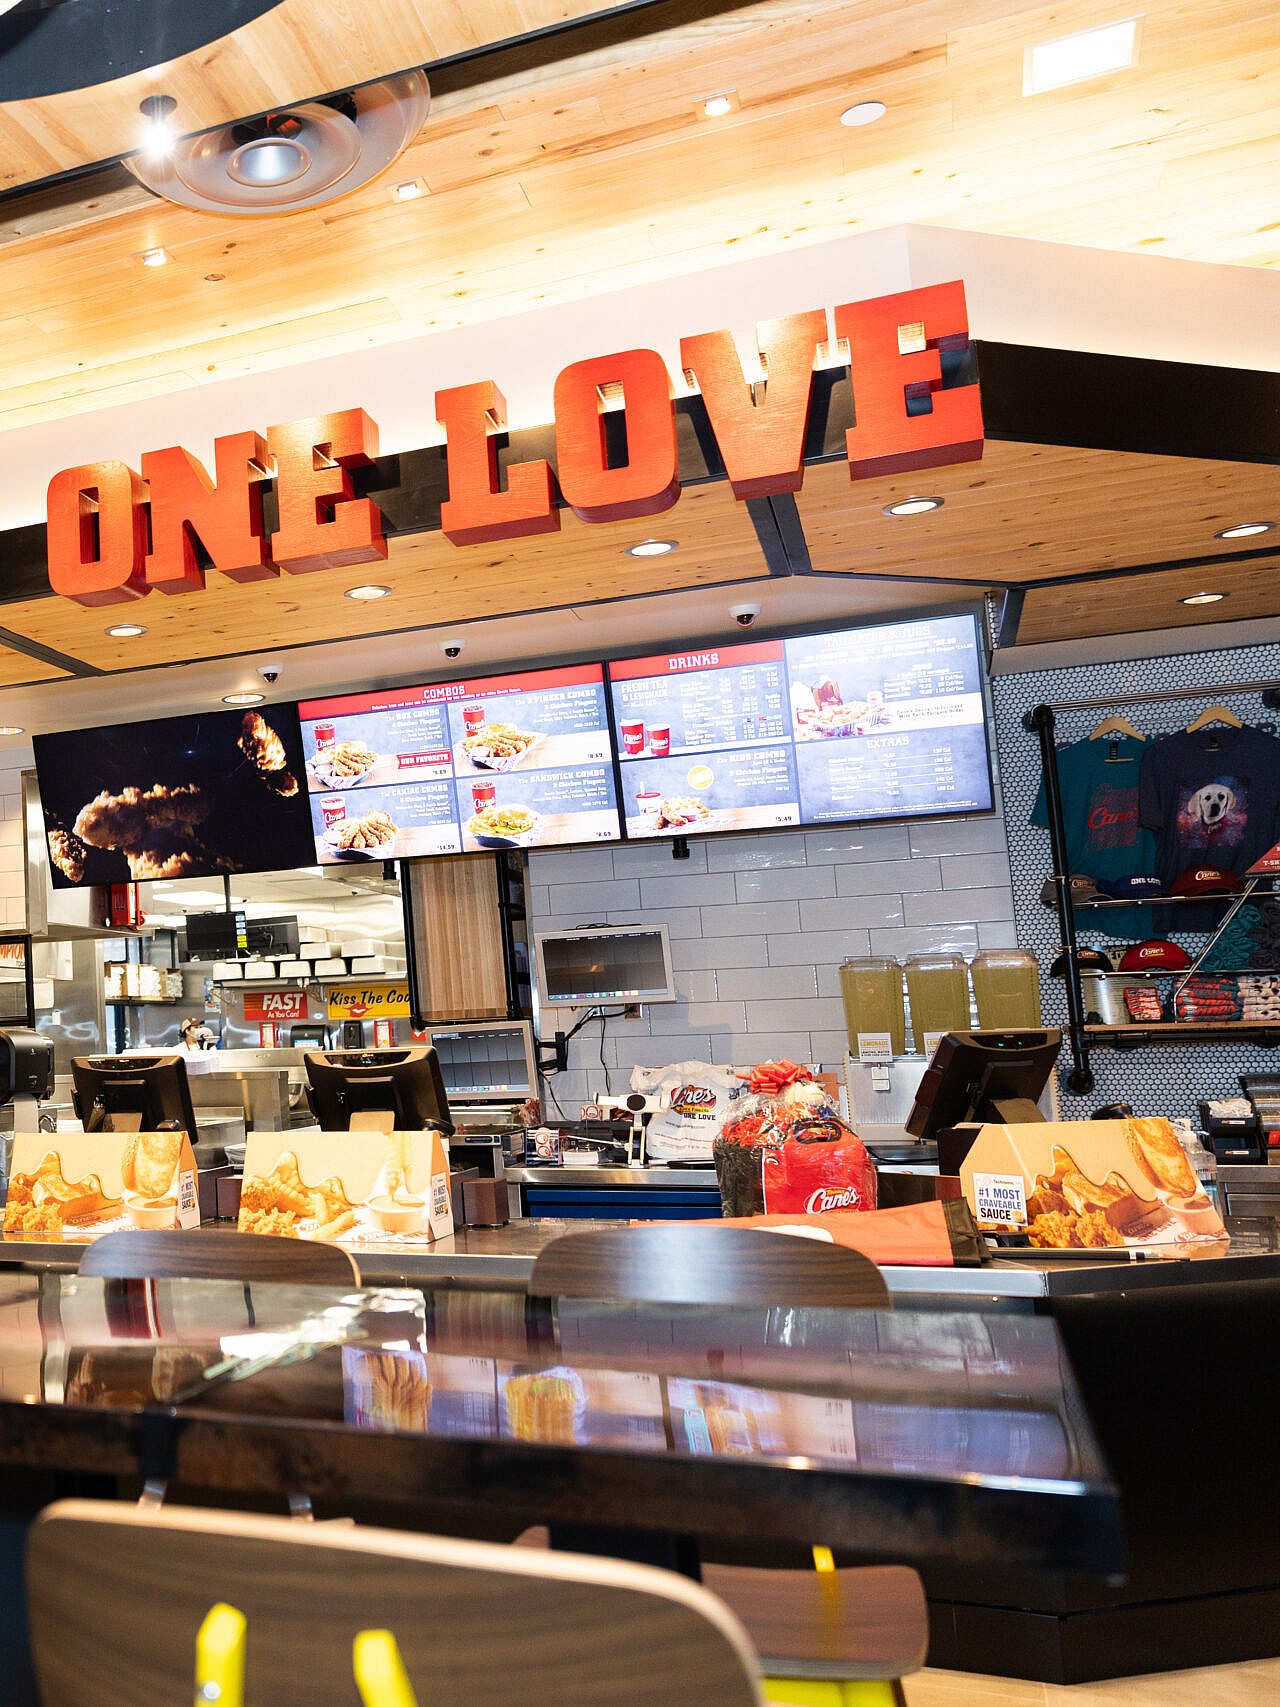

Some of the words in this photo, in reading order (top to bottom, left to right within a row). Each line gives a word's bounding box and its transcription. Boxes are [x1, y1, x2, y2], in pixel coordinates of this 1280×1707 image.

[47, 408, 388, 608] ONE
[434, 280, 983, 547] LOVE
[669, 653, 720, 670] DRINKS
[424, 685, 465, 699] COMBOS
[621, 682, 649, 693] FRESH
[652, 679, 668, 690] TEA
[567, 689, 596, 699] COMBO
[867, 736, 910, 749] EXTRAS
[416, 753, 448, 763] FAVORITE
[754, 750, 785, 759] COMBO
[530, 772, 574, 783] SANDWICH
[576, 769, 605, 778] COMBO
[262, 993, 304, 1011] FAST
[329, 991, 356, 1006] Kiss
[360, 990, 383, 1004] The
[386, 989, 411, 1004] Coo
[275, 1010, 285, 1018] You
[285, 1010, 300, 1018] Can!
[979, 1187, 989, 1198] #1
[993, 1188, 1020, 1200] MOST
[806, 1186, 861, 1215] Cane's
[979, 1199, 1021, 1210] CRAVEABLE
[981, 1208, 1011, 1220] SAUCE
